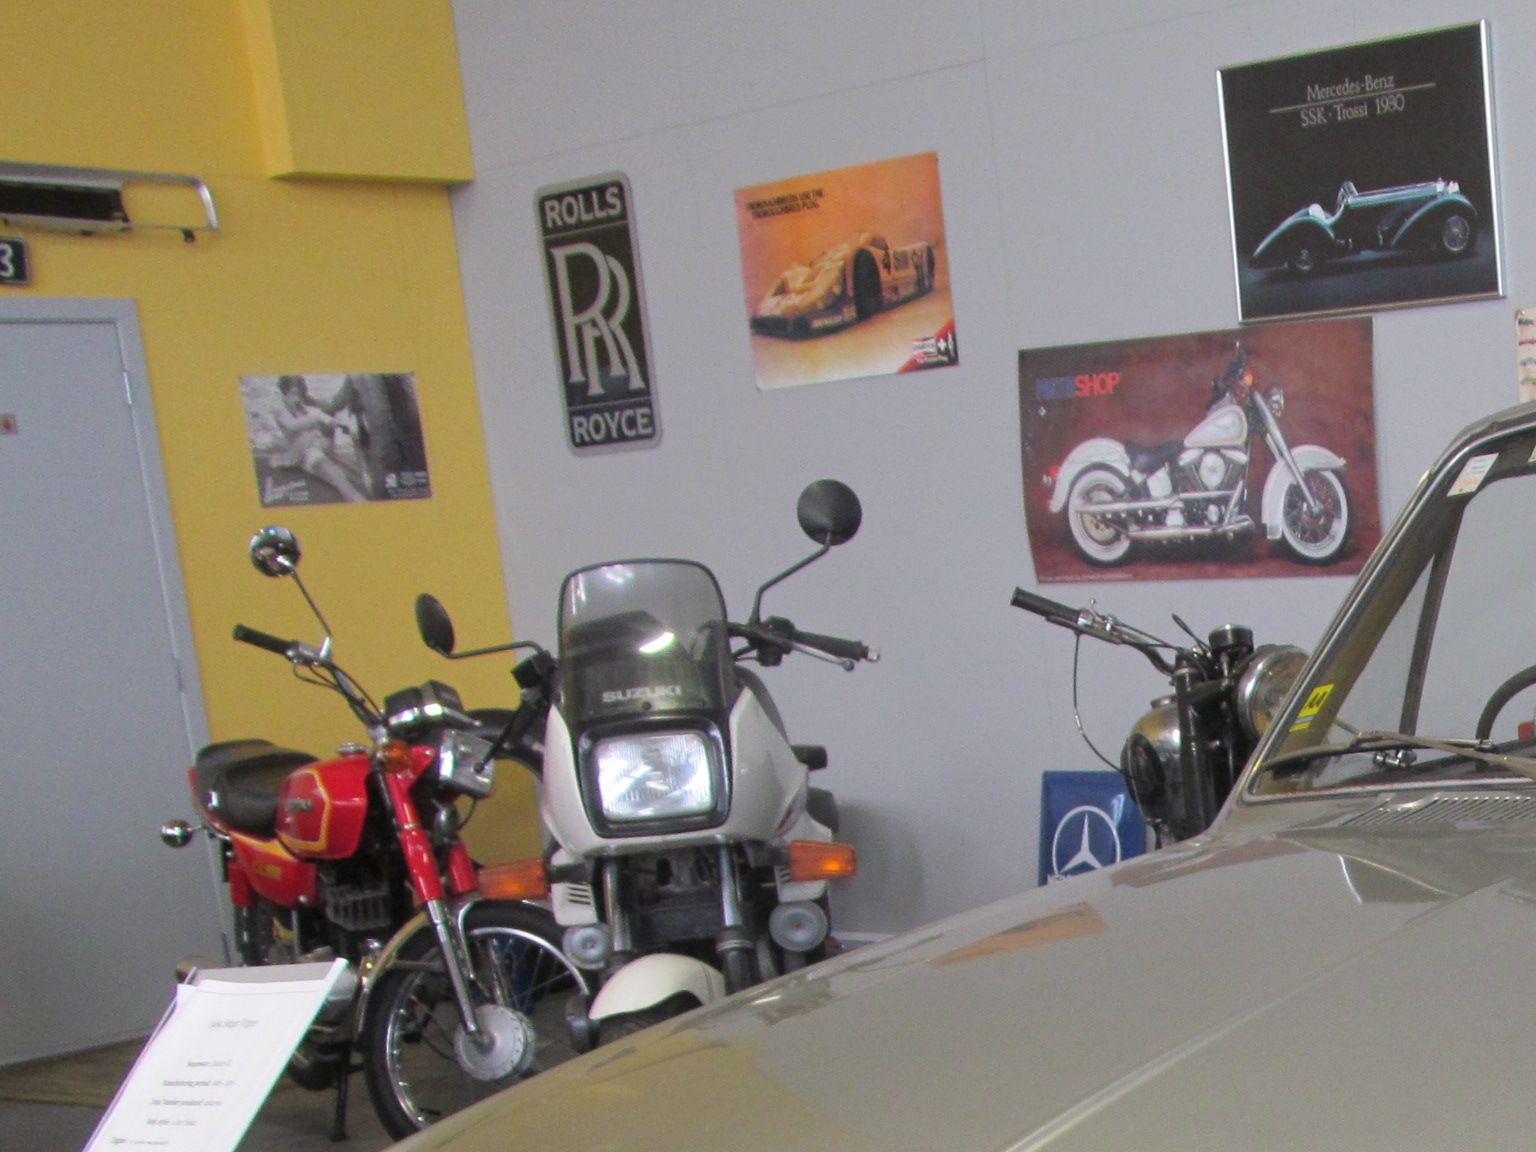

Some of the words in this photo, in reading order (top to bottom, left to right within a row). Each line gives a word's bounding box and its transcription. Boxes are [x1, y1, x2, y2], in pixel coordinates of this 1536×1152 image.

[1300, 107, 1328, 127] SSK
[1333, 102, 1368, 121] Trossi
[544, 186, 623, 228] ROLLS
[572, 407, 654, 443] ROYCE
[602, 685, 682, 702] SUZUKI
